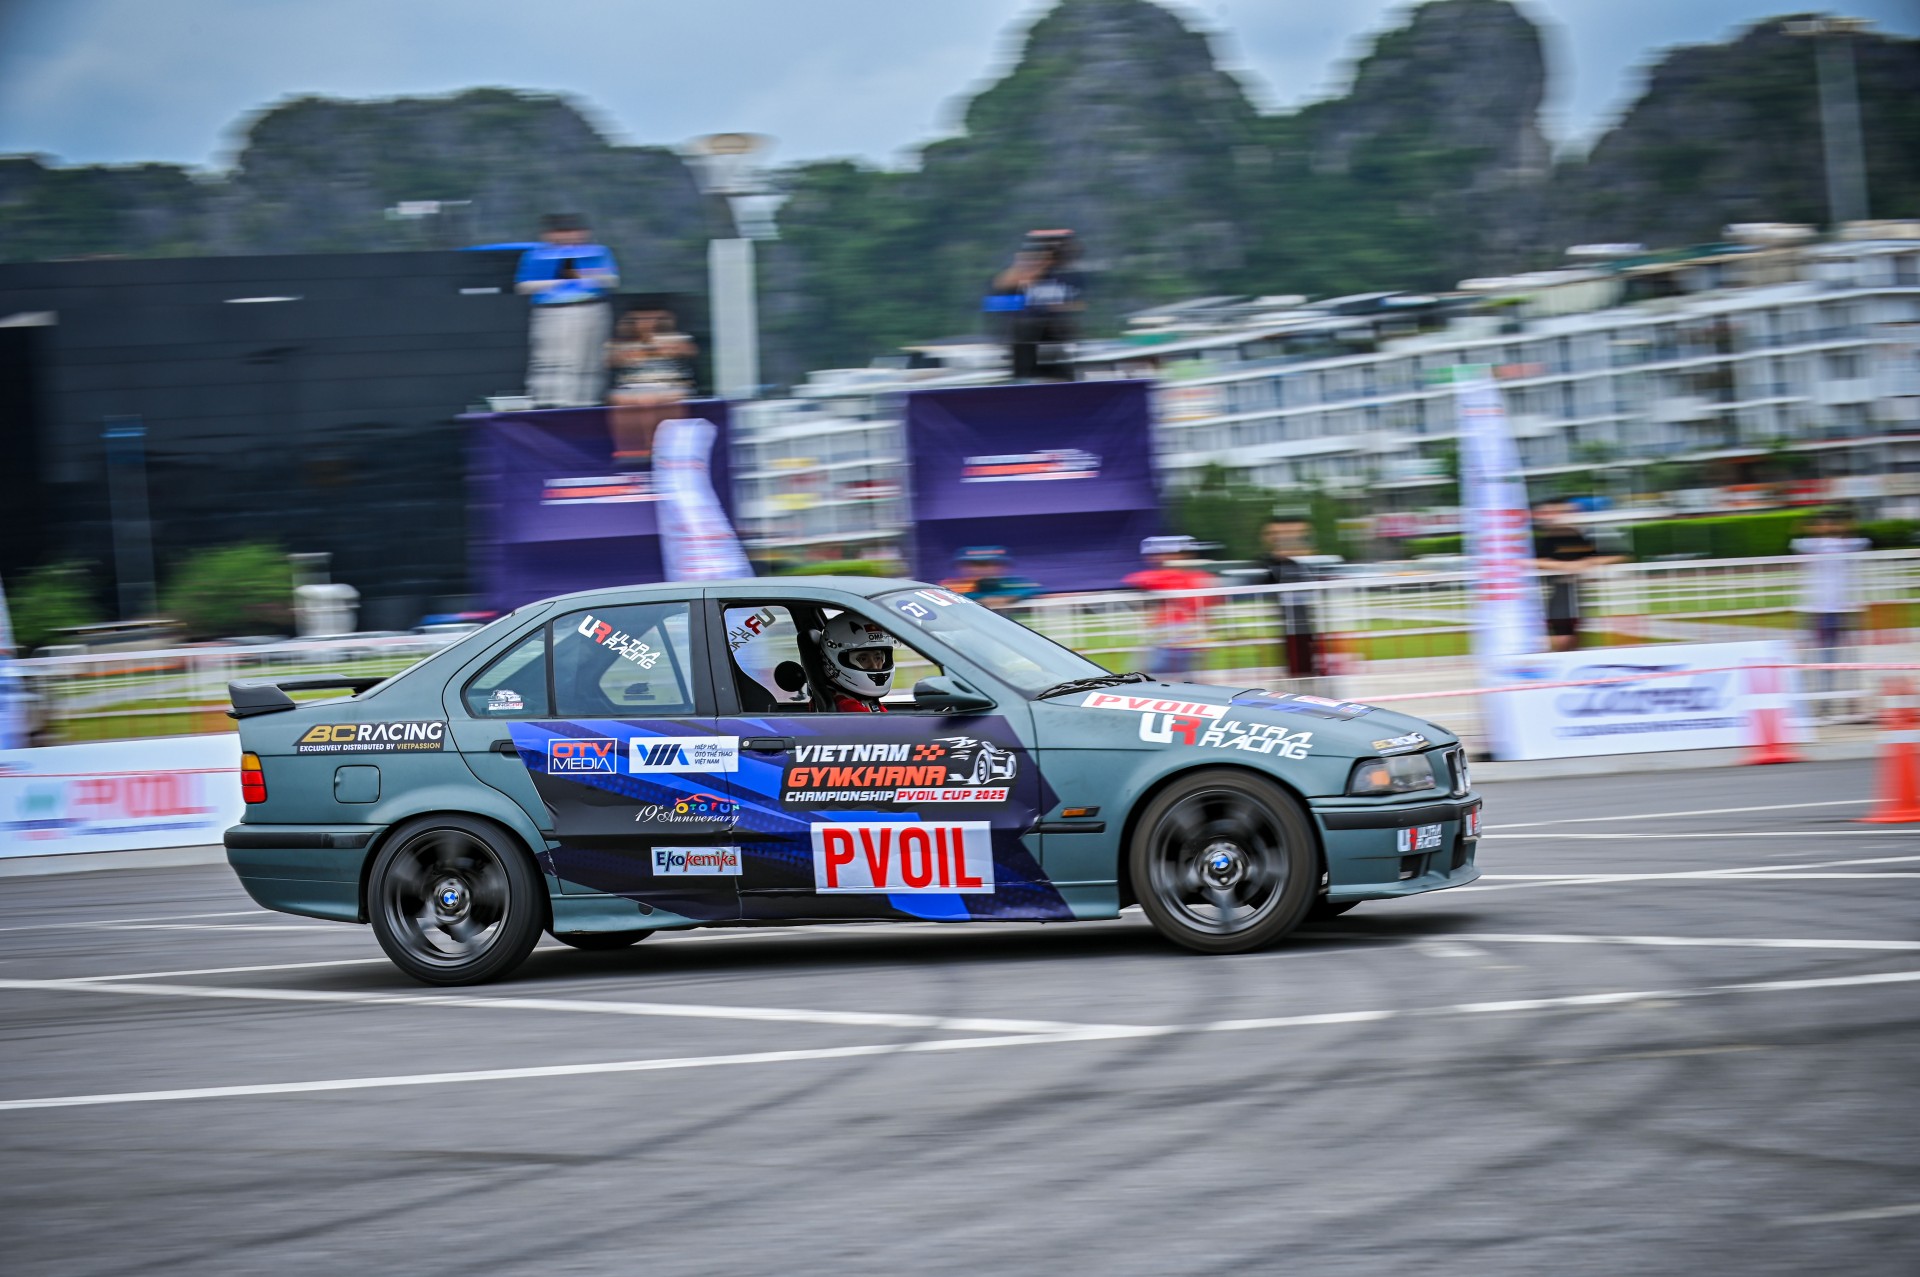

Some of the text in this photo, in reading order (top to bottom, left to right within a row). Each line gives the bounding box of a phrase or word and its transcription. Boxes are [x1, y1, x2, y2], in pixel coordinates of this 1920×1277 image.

[901, 602, 928, 618] 27
[577, 614, 613, 644] UR
[602, 637, 657, 670] RACING
[611, 630, 661, 661] ULTRA
[1092, 694, 1215, 717] PVOIL
[300, 722, 443, 742] BC RACING
[1139, 712, 1203, 746] UR
[1208, 719, 1313, 744] ULTRA
[300, 744, 342, 752] EXCLUSIVELY
[343, 743, 384, 751] DISTRIBUTED
[396, 742, 440, 750] VIETPASSION
[552, 742, 612, 758] OTV
[794, 743, 911, 762] VIETNAM
[1198, 731, 1313, 760] RACING
[553, 758, 613, 772] MEDIA
[787, 765, 947, 787] GYMKHANA
[784, 789, 1006, 802] CHAMPIONSHIP PVOIL CUP 2025
[657, 808, 740, 827] Anniversary
[656, 850, 738, 872] Ekokemika
[822, 827, 983, 888] PVOIL
